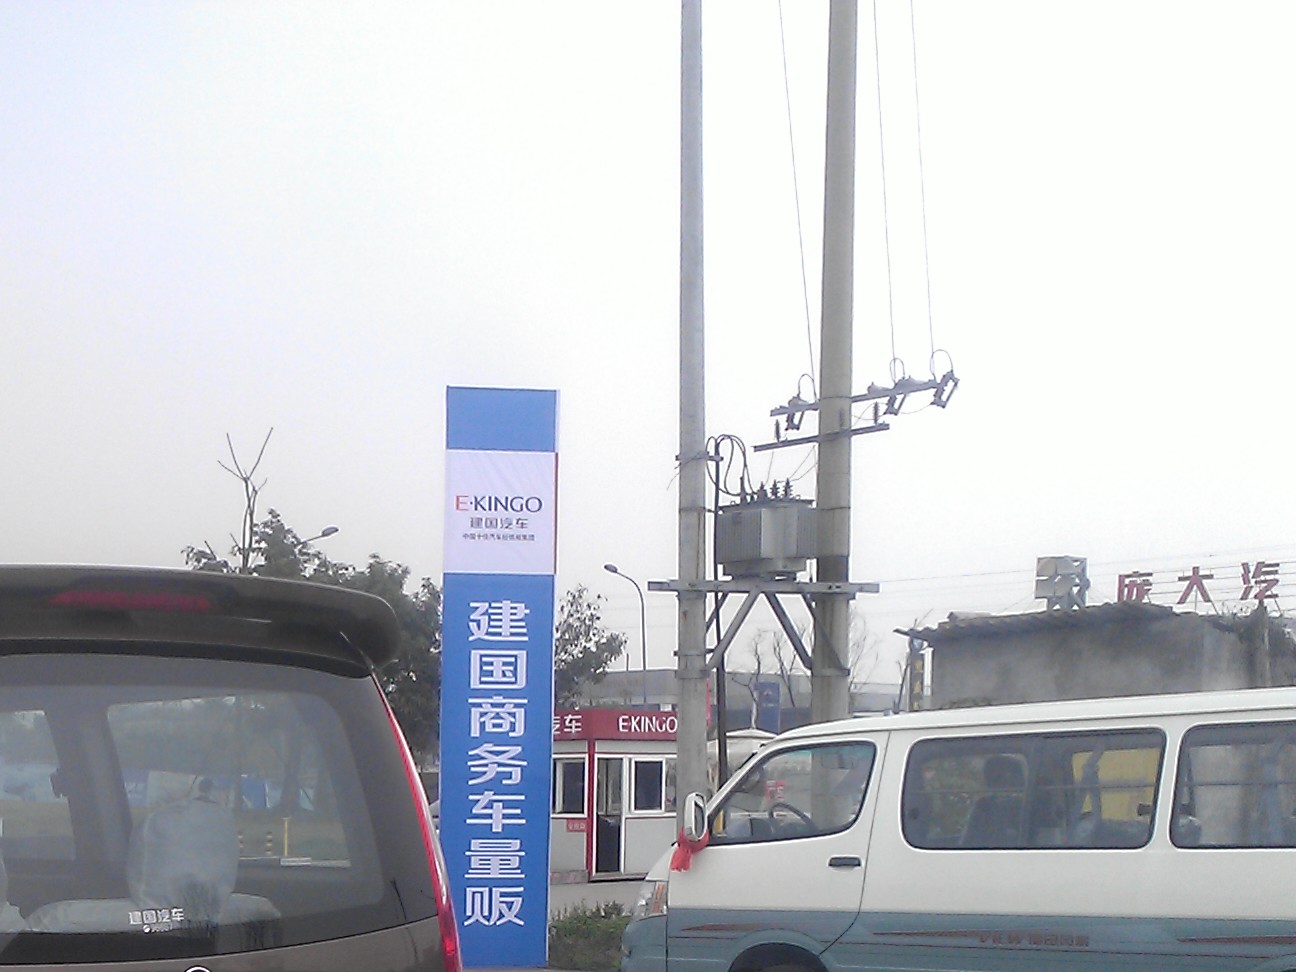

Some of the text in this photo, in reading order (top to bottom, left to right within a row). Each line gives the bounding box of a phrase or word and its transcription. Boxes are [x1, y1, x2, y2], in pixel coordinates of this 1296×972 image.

[470, 517, 528, 529] 建国汽车
[464, 600, 530, 926] 建国商务车量贩
[128, 908, 184, 925] 建国汽车
